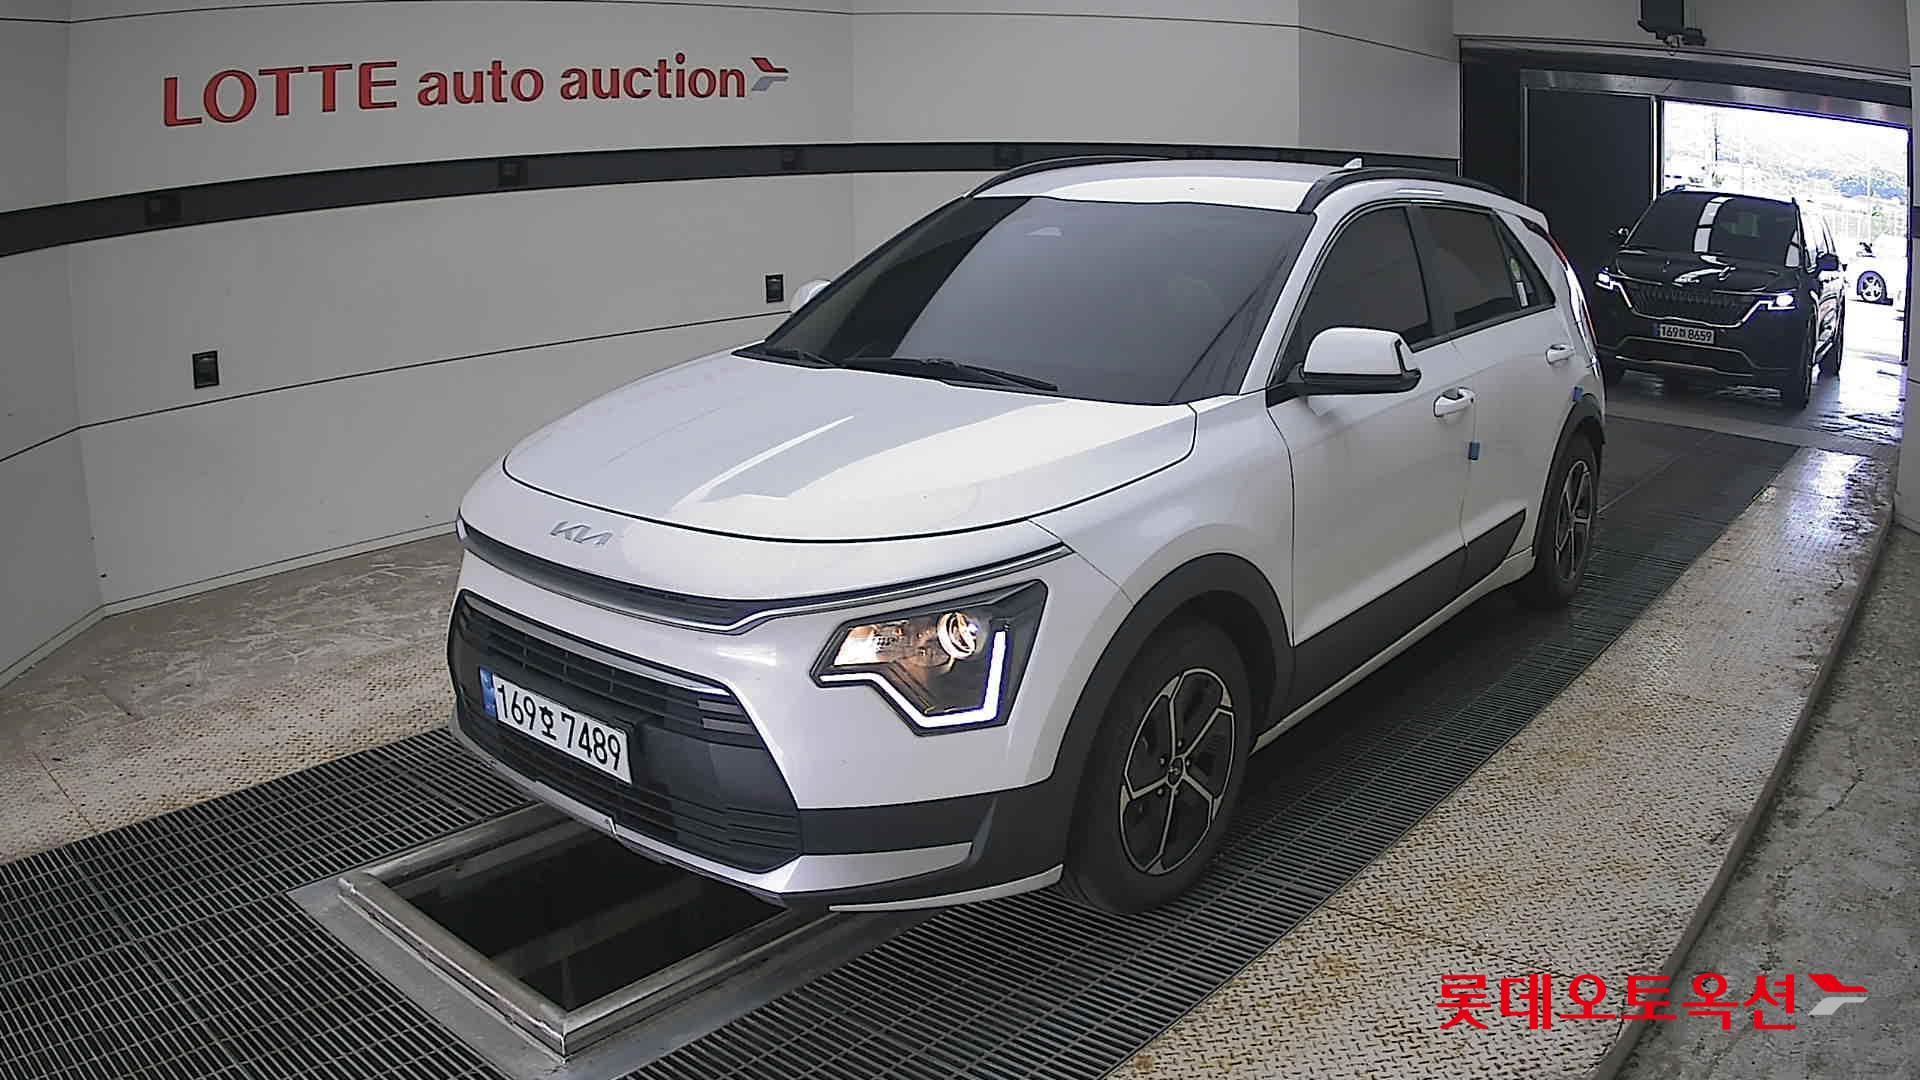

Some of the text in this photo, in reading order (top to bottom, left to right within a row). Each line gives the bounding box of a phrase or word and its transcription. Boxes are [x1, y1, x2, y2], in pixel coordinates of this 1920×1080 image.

[163, 52, 747, 127] LOTTE auto auction
